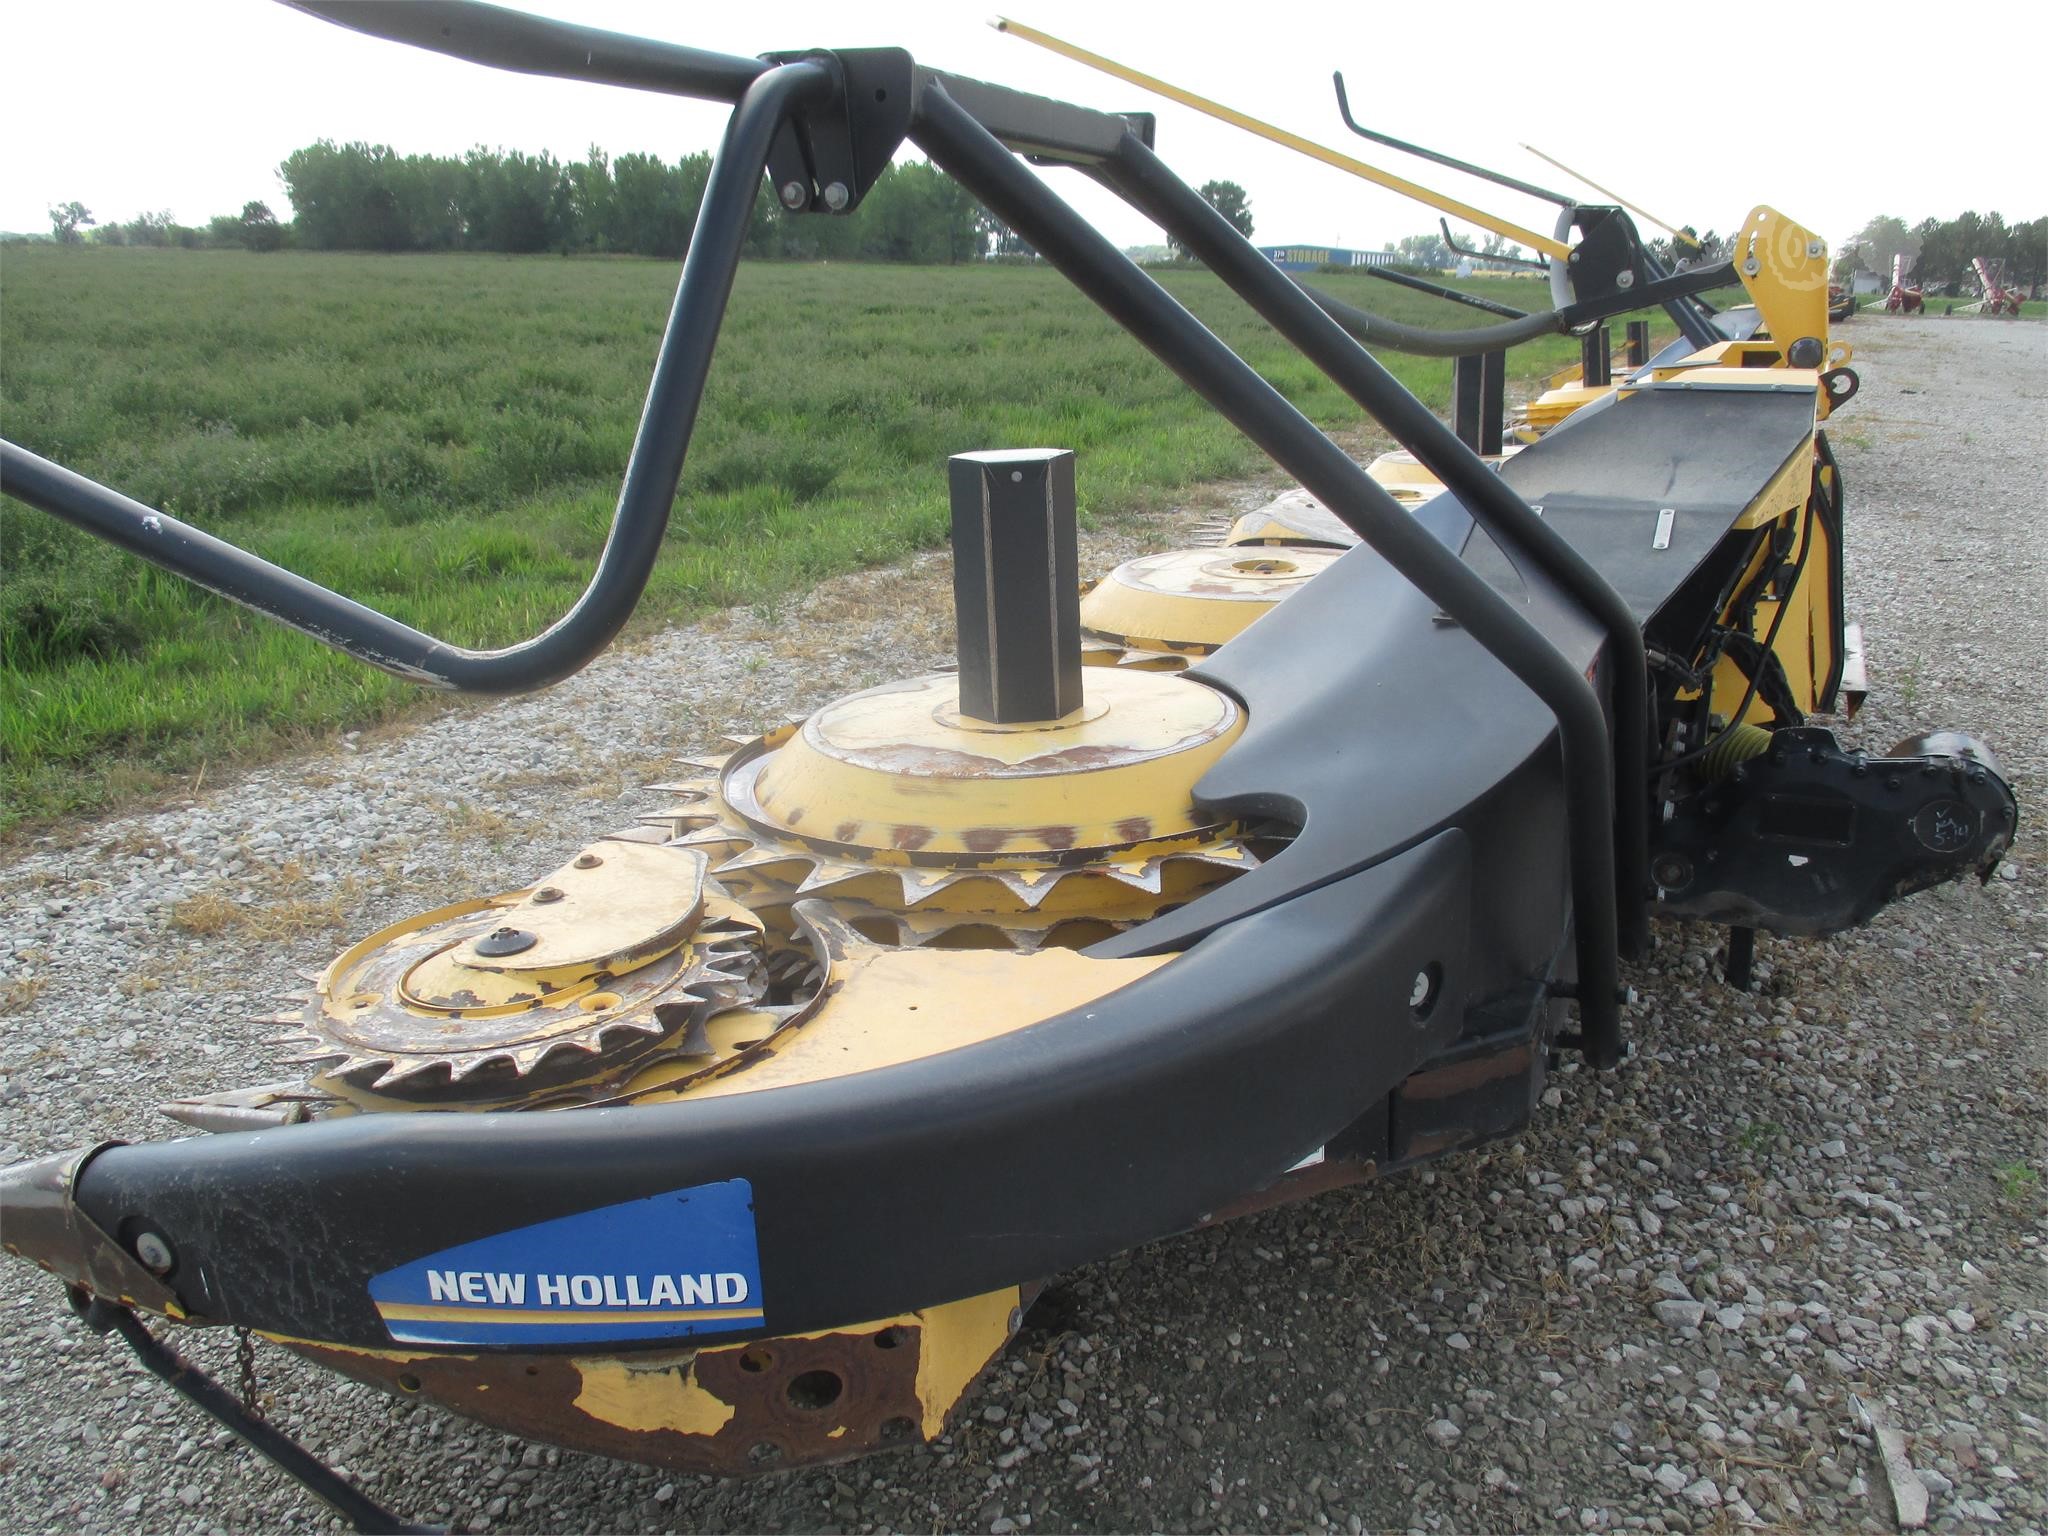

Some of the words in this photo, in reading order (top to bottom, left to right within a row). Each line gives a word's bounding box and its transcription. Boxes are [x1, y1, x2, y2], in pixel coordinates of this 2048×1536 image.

[1287, 250, 1329, 263] STORAGE
[427, 1270, 525, 1304] NEW
[537, 1272, 749, 1306] HOLLAND
